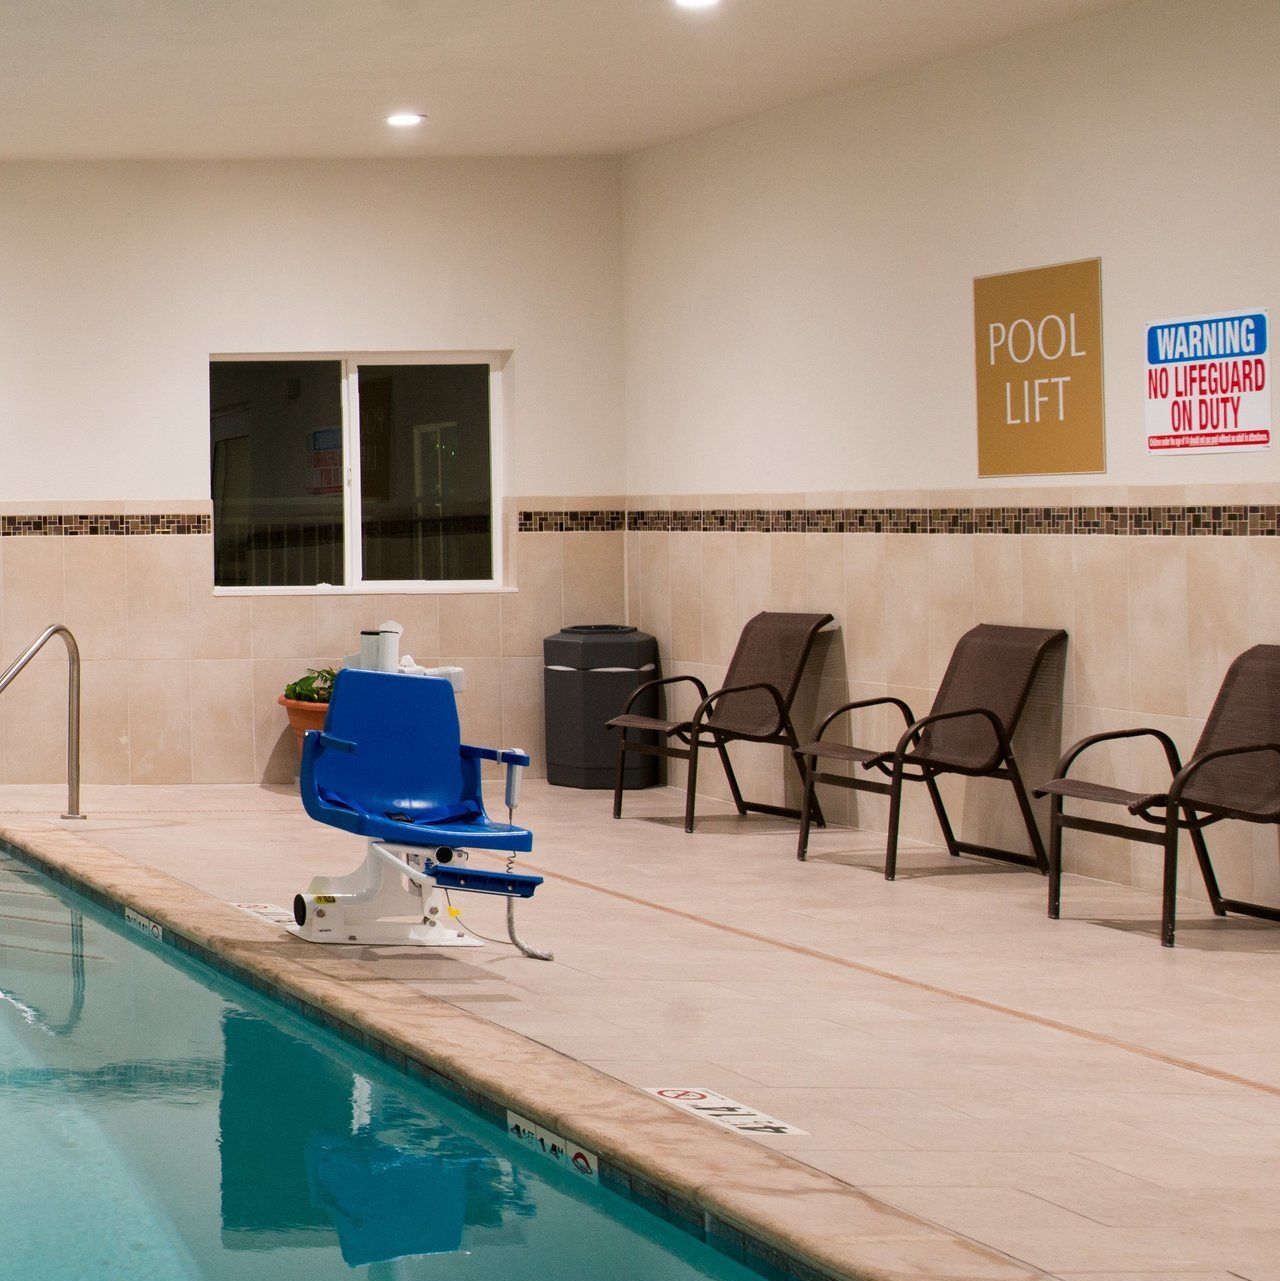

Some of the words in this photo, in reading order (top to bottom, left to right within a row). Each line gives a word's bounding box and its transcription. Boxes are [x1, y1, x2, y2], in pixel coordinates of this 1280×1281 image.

[989, 312, 1086, 366] POOL
[1156, 318, 1256, 361] WARNING
[1005, 376, 1072, 425] LIFT
[1148, 367, 1169, 400] NO
[1175, 358, 1266, 397] LIFEGUARD
[1171, 400, 1193, 432] ON
[1199, 396, 1242, 431] DUTY
